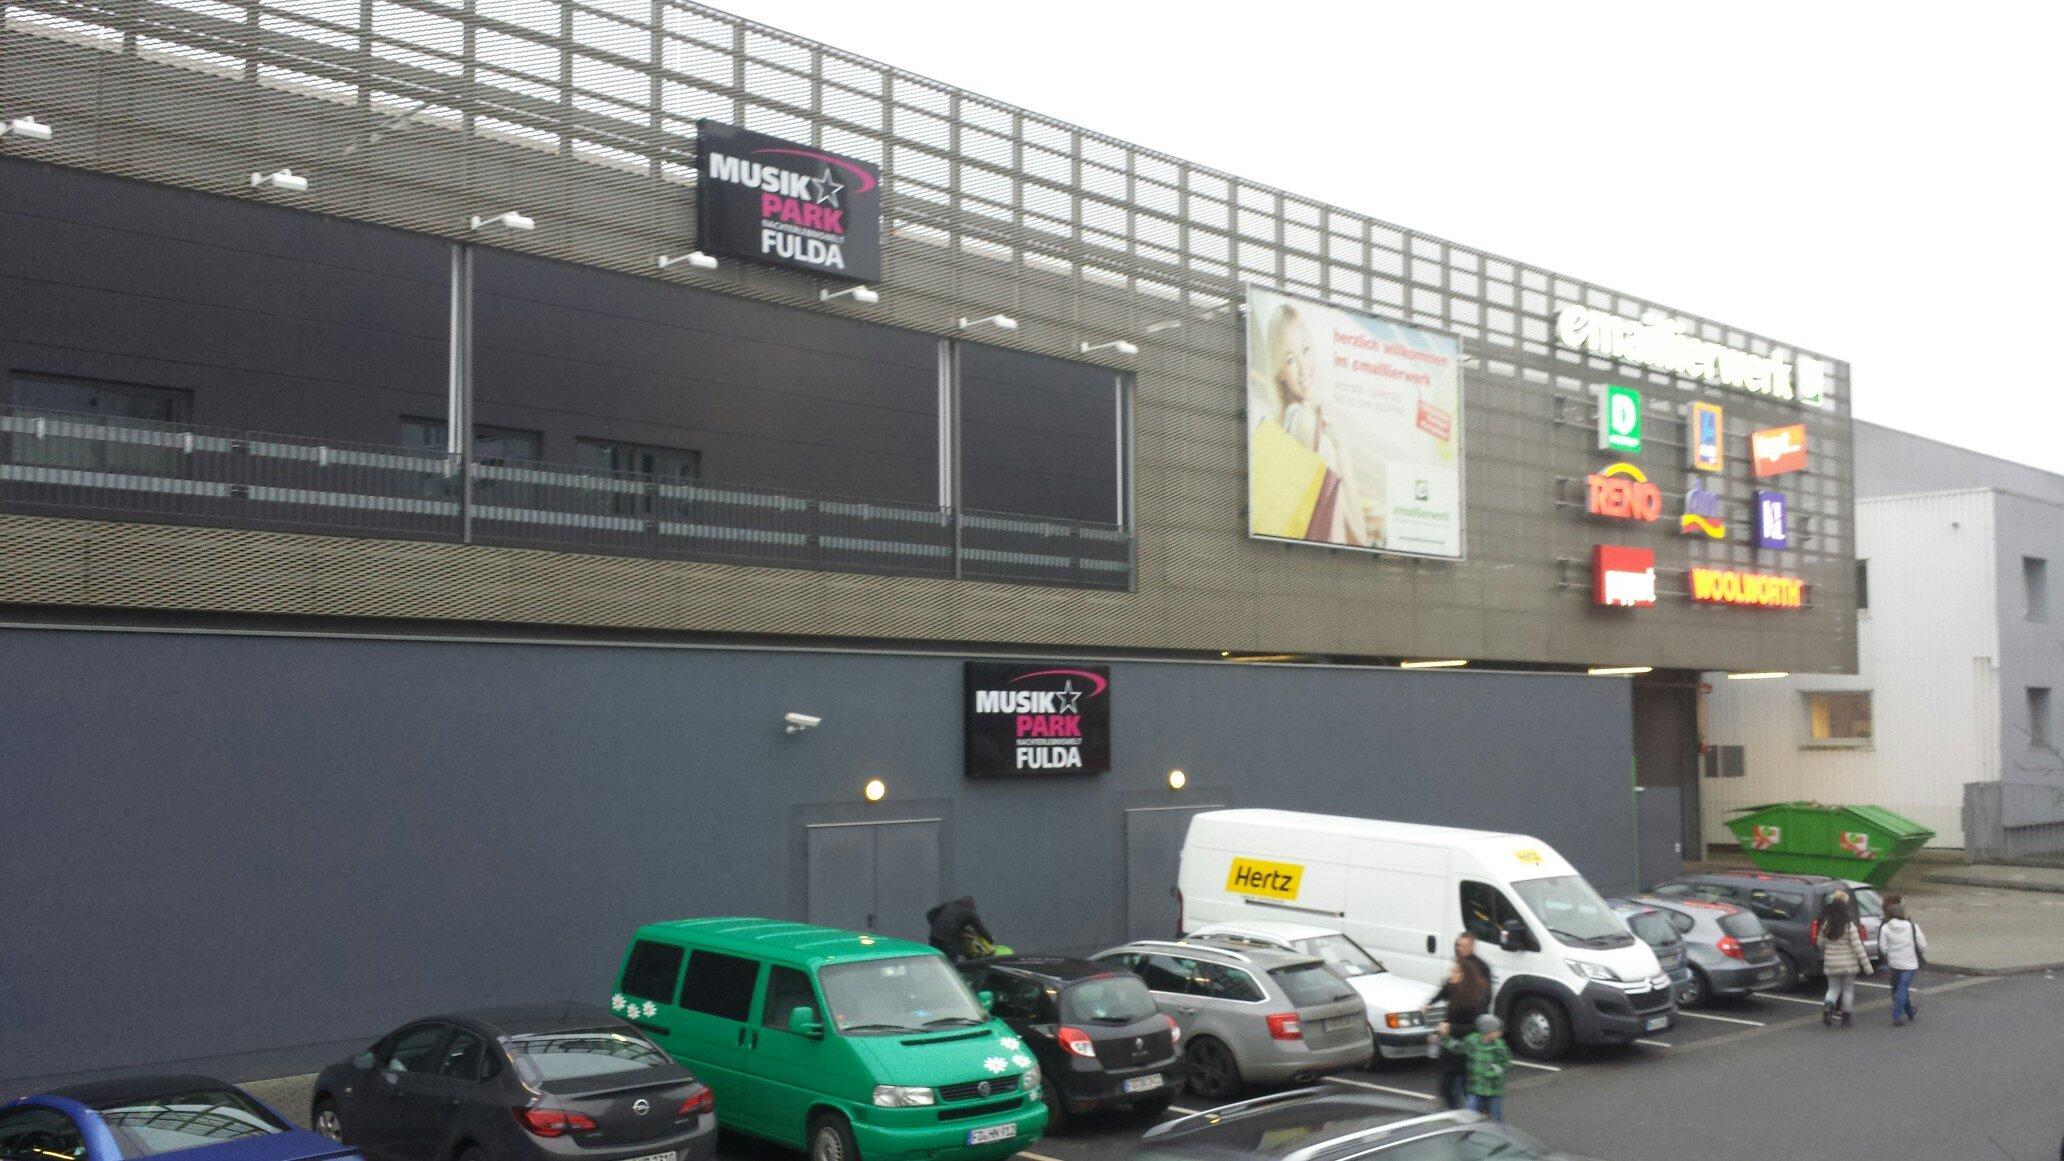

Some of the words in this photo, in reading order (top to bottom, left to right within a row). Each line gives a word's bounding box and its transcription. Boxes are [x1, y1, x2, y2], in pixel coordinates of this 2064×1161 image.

[709, 152, 811, 201] MUSIK
[761, 192, 844, 234] PARK
[761, 228, 845, 269] FULDA
[1611, 394, 1636, 435] D
[1587, 474, 1662, 522] RENO
[1689, 567, 1804, 607] WOOLWORTH
[975, 690, 1056, 714] MUSIK
[1015, 715, 1082, 737] PARK
[1016, 746, 1083, 769] FULDA
[1234, 865, 1293, 892] Hertz
